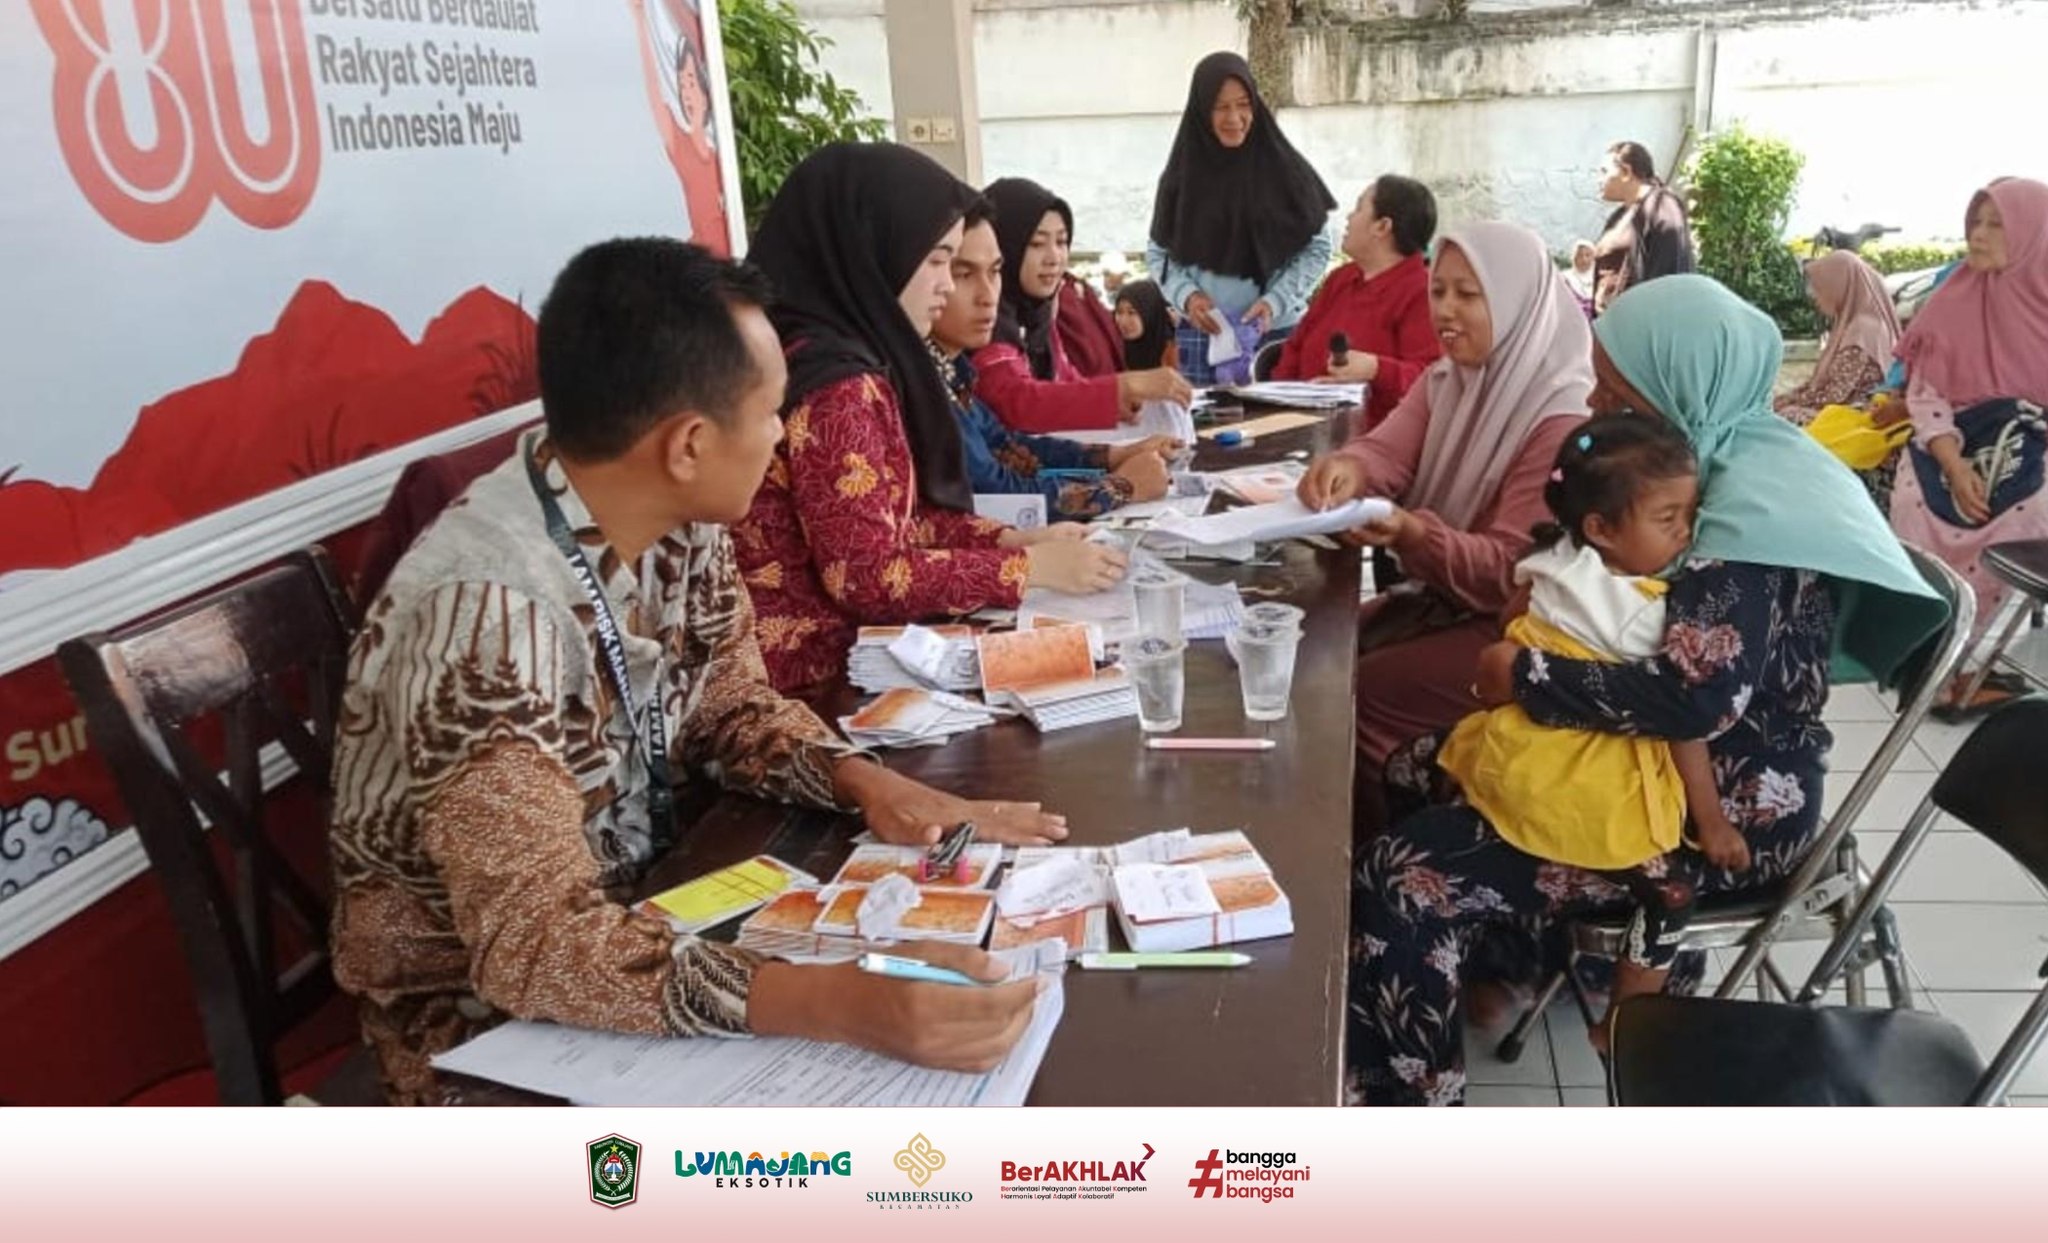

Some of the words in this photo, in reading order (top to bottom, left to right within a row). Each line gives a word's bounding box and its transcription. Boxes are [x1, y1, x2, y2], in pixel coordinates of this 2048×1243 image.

[315, 33, 421, 97] Rakyat
[423, 39, 538, 98] Sejahtera
[327, 100, 464, 153] Indonesia
[466, 100, 523, 155] Maju
